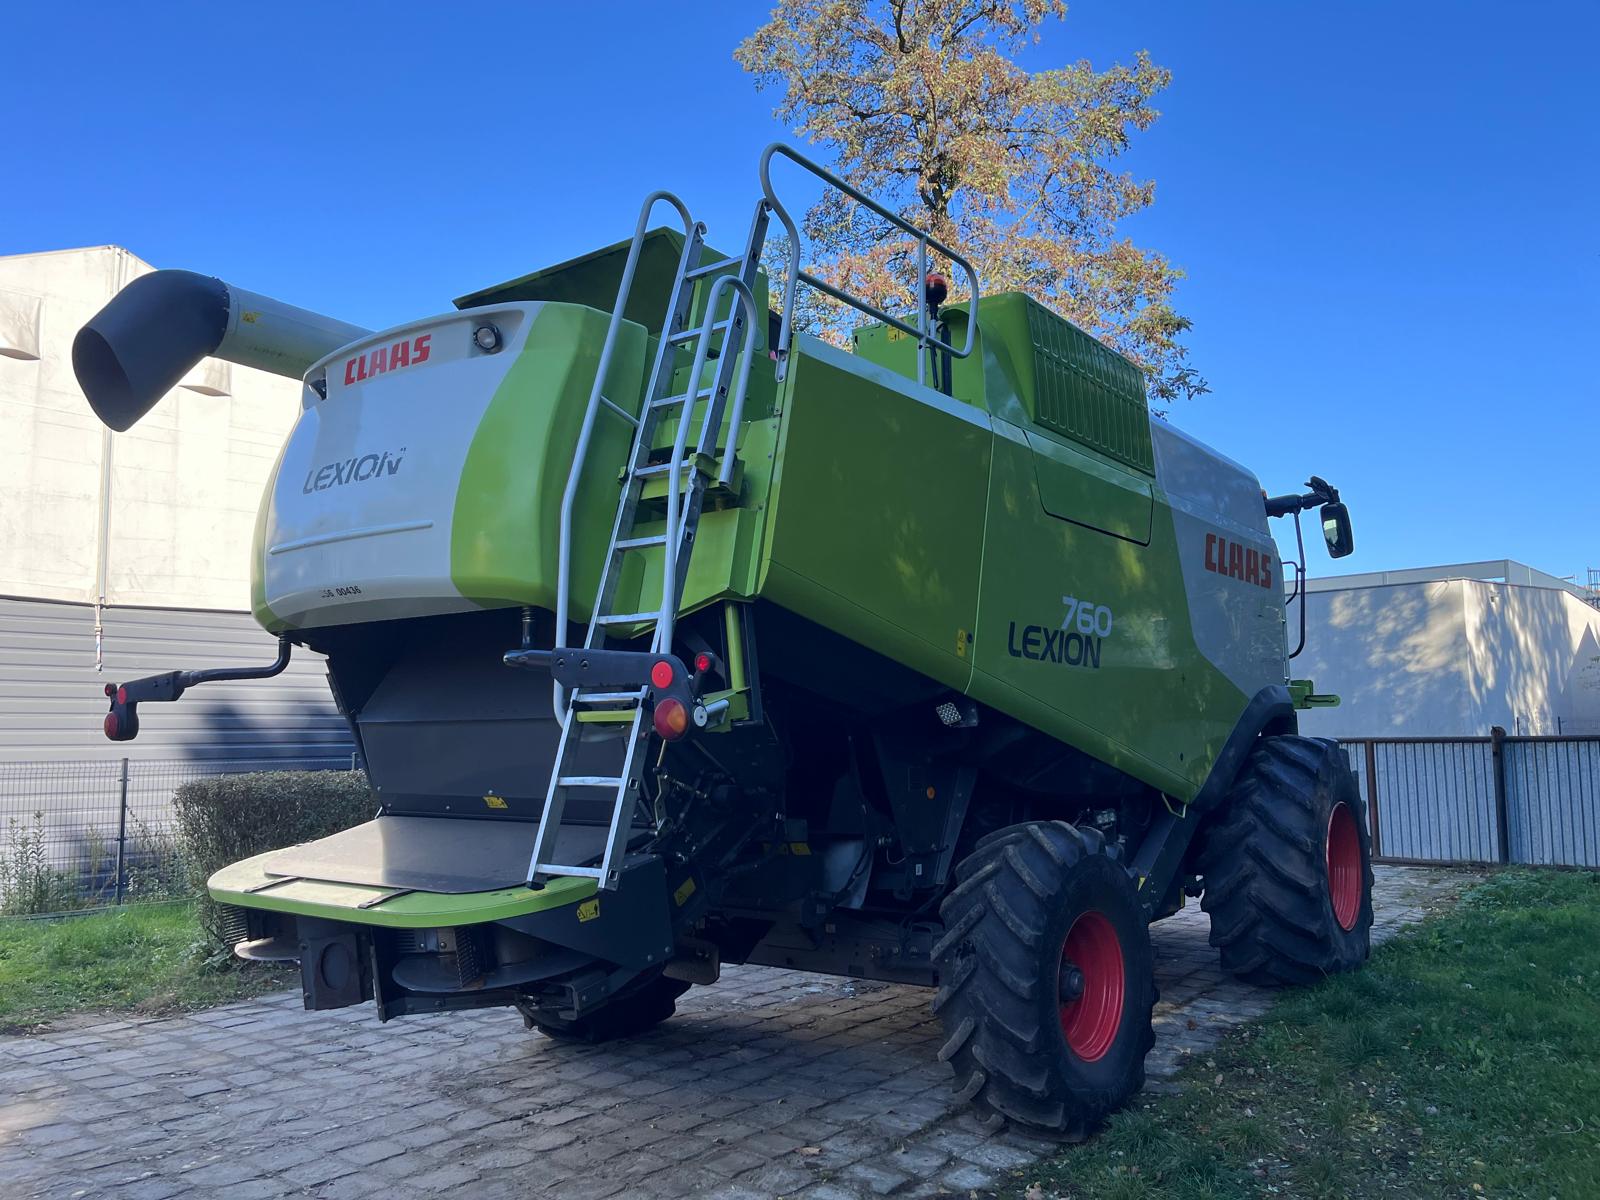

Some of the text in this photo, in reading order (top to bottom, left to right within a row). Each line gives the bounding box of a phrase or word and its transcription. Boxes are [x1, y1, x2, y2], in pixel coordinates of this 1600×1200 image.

[344, 334, 431, 386] CLAAS
[302, 448, 407, 495] LEXION
[1205, 533, 1272, 589] CLAAS
[336, 585, 362, 596] 00436
[1061, 596, 1112, 637] 760
[1008, 621, 1101, 669] LEXION
